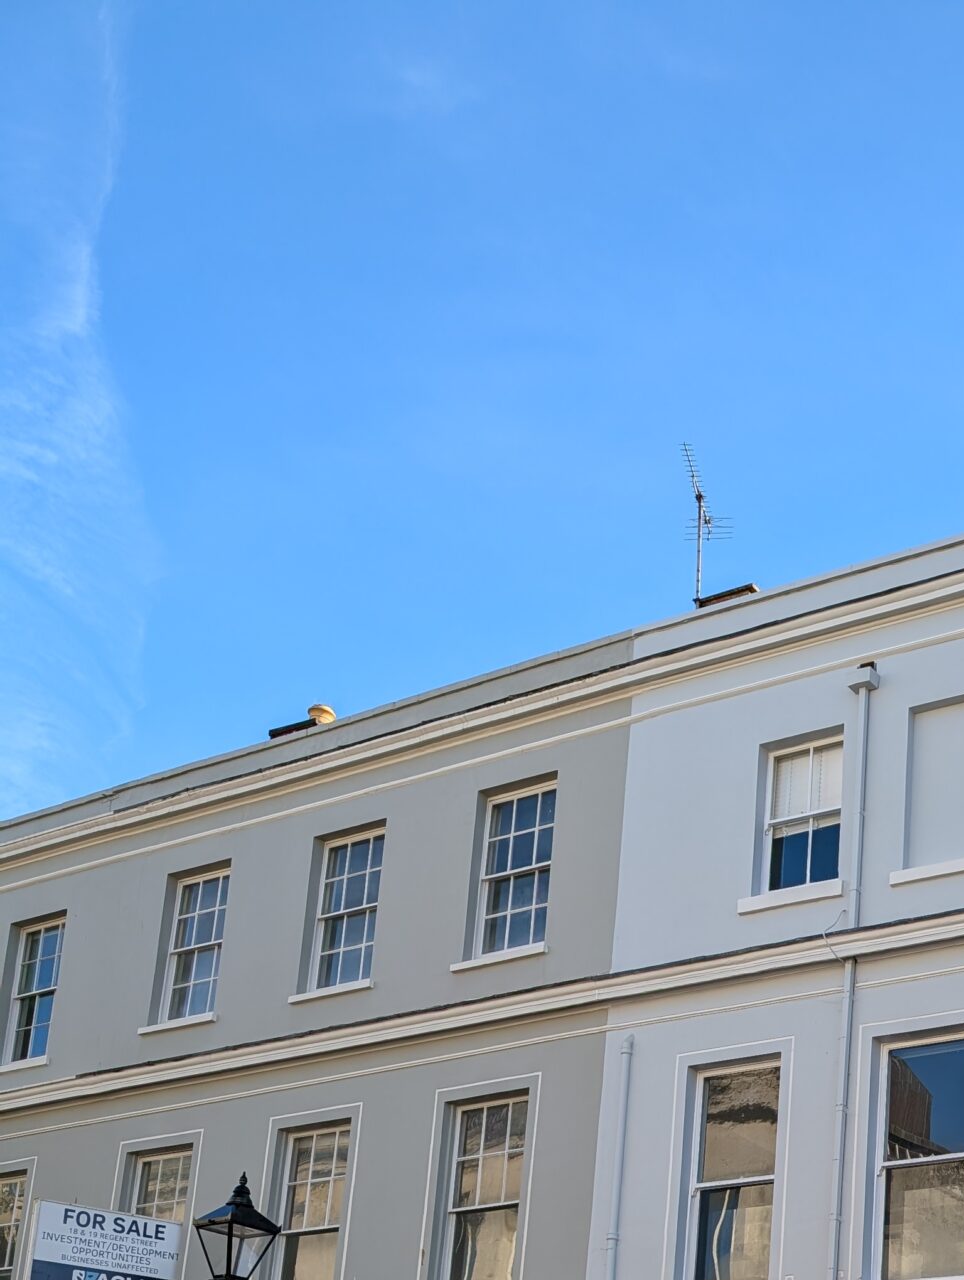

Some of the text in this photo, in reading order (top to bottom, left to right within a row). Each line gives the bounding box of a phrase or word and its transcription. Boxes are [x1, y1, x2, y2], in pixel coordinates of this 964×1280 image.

[63, 1208, 167, 1241] FOR SALE
[41, 1231, 179, 1261] INVESTMENT/DEVELOPMENT
[69, 1227, 79, 1235] 18
[100, 1232, 129, 1243] REGENT
[130, 1237, 158, 1248] STREET
[61, 1253, 159, 1275] BUSINESSES UNAFFECTED
[71, 1245, 152, 1266] OPPORTUNITIES
